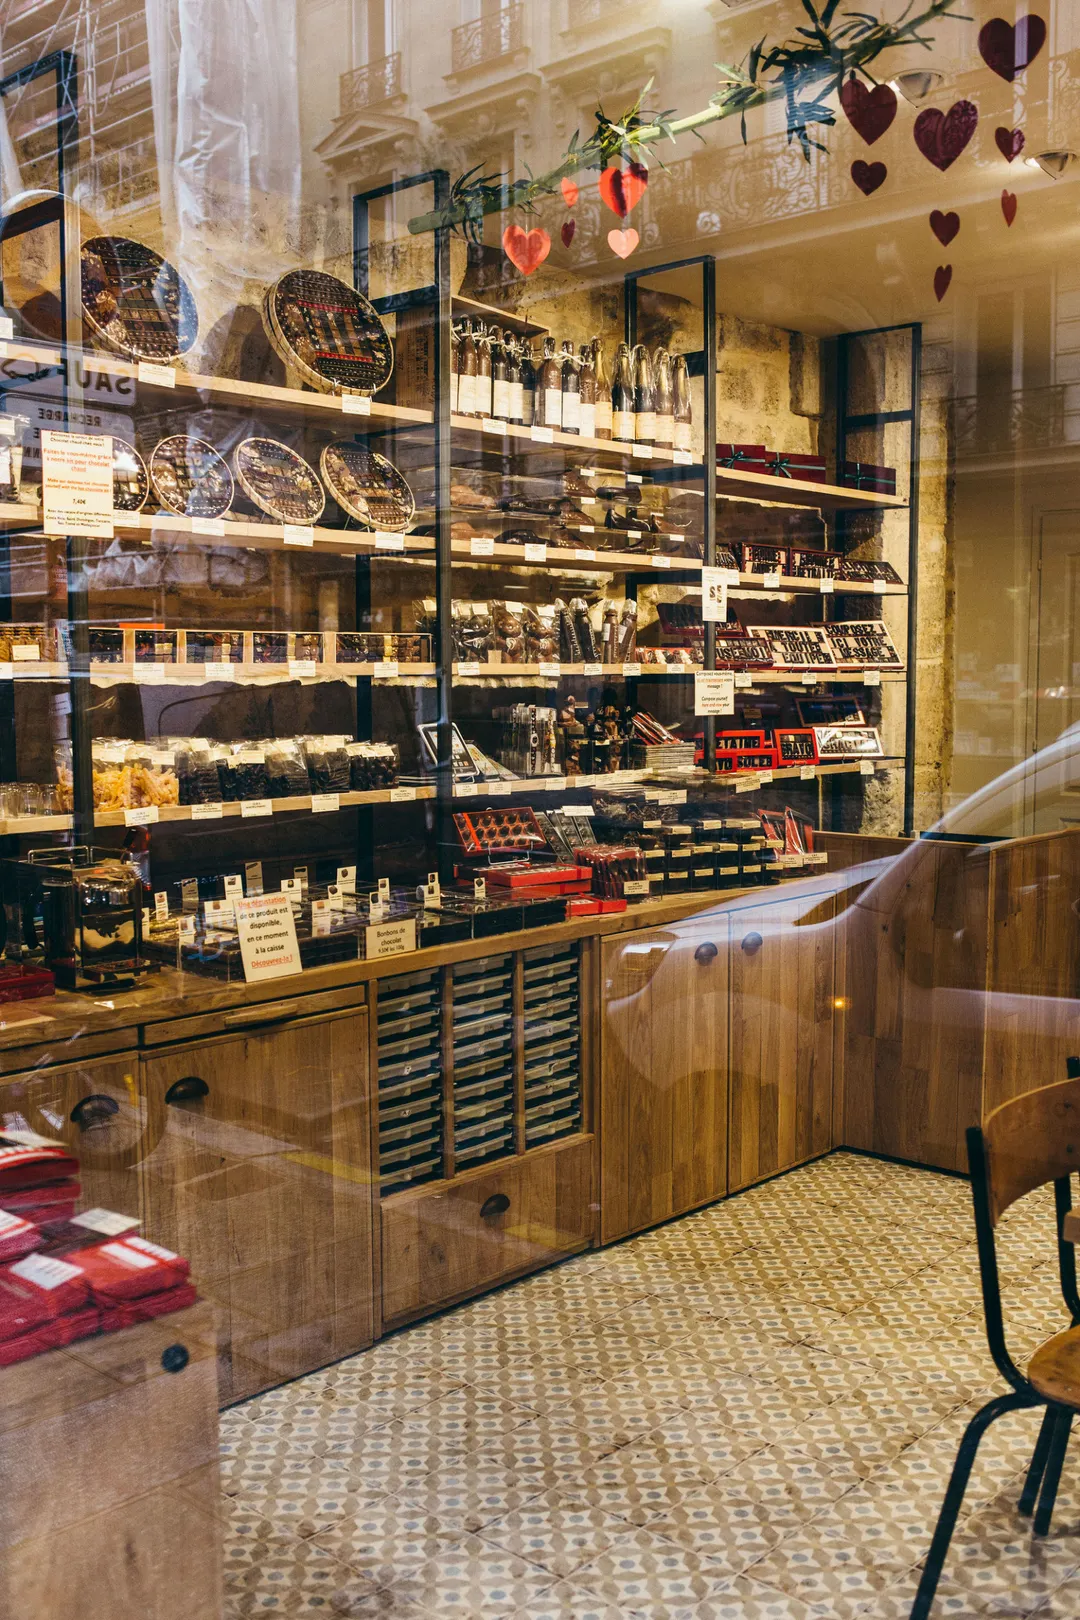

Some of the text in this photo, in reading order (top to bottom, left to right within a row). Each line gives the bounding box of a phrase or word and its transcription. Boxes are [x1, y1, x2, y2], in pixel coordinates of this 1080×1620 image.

[825, 624, 876, 635] COMPOSEZ
[831, 636, 887, 648] ICI VOTRE
[840, 647, 885, 658] MESSAGE
[256, 908, 278, 918] produit
[264, 931, 289, 940] moment
[381, 937, 402, 946] chocolat
